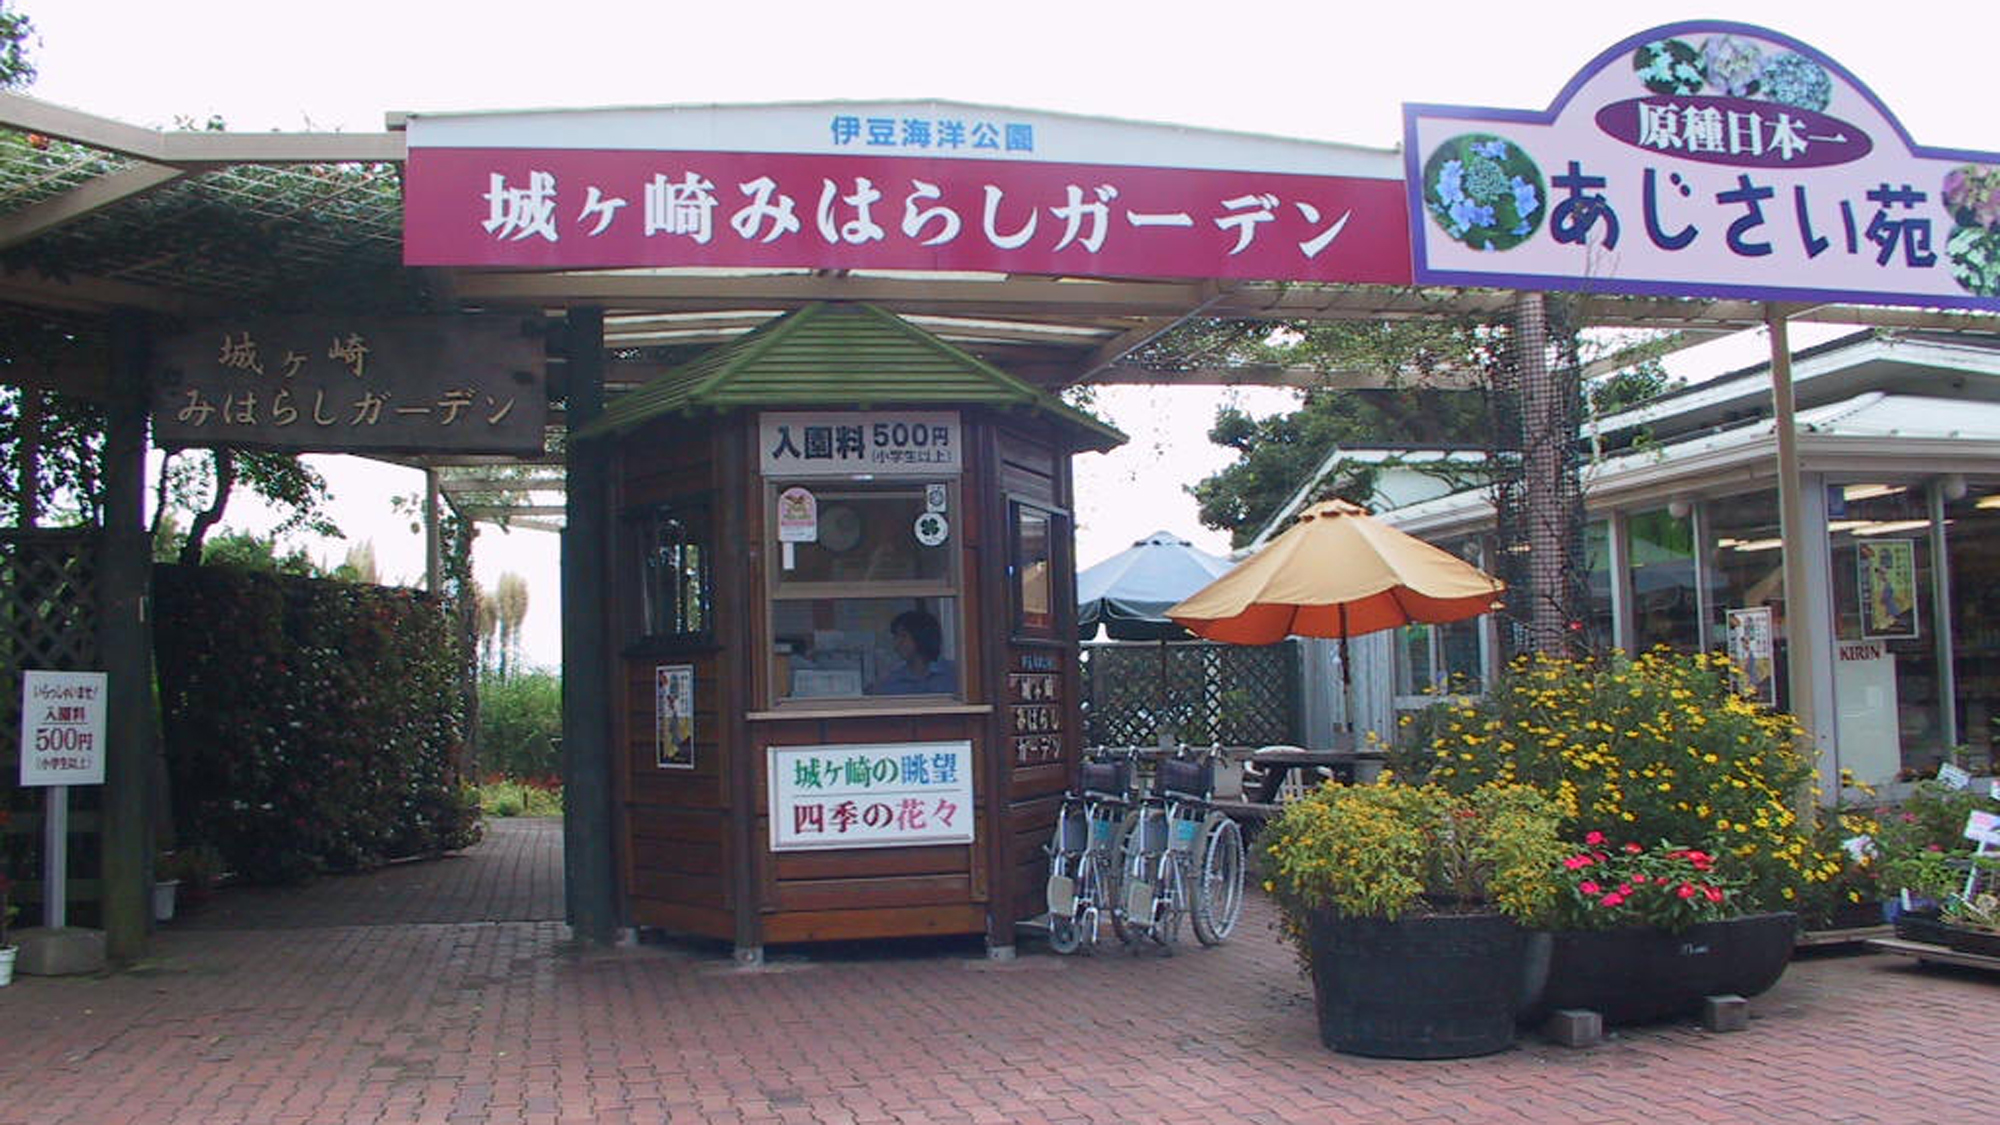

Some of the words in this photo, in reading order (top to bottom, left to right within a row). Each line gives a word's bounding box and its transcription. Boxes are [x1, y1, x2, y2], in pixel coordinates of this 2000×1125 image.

[831, 114, 1033, 152] 伊豆海洋公園
[1637, 101, 1848, 161] 原種日本一
[481, 170, 1352, 259] 城ヶ崎みはらしガーデン
[1549, 160, 1938, 270] あじさい苑
[177, 387, 516, 427] みはらしガーデン
[772, 424, 866, 460] 入園料
[872, 423, 949, 447] 500円
[1838, 646, 1882, 661] KIRIN
[45, 705, 86, 721] 入園料
[35, 727, 94, 751] 500円
[792, 797, 959, 835] 四季の花々
